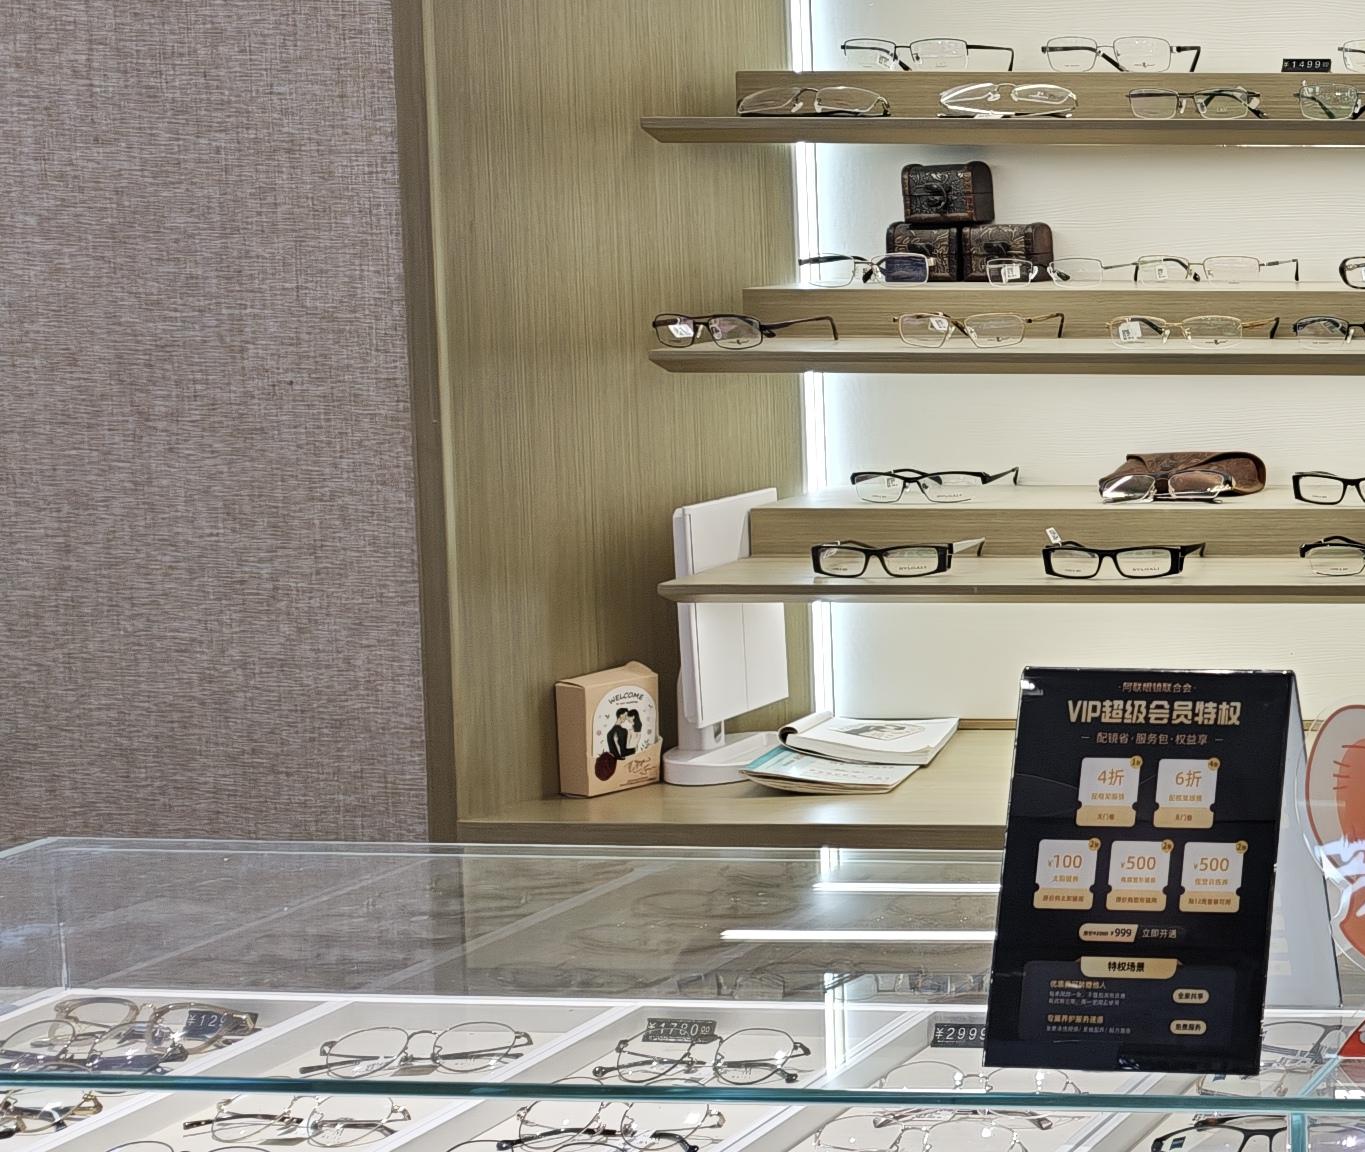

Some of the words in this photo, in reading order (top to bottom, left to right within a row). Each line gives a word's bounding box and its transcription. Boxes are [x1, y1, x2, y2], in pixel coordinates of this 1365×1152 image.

[609, 692, 643, 704] WELCOME
[1067, 699, 1242, 726] VIP超级会员特权
[1097, 768, 1125, 786] 4折
[1175, 770, 1202, 787] 6折
[1120, 856, 1156, 870] ¥500
[1193, 858, 1229, 872] ¥500
[1142, 929, 1177, 939] 立即开通
[1107, 961, 1145, 972] 特权场景
